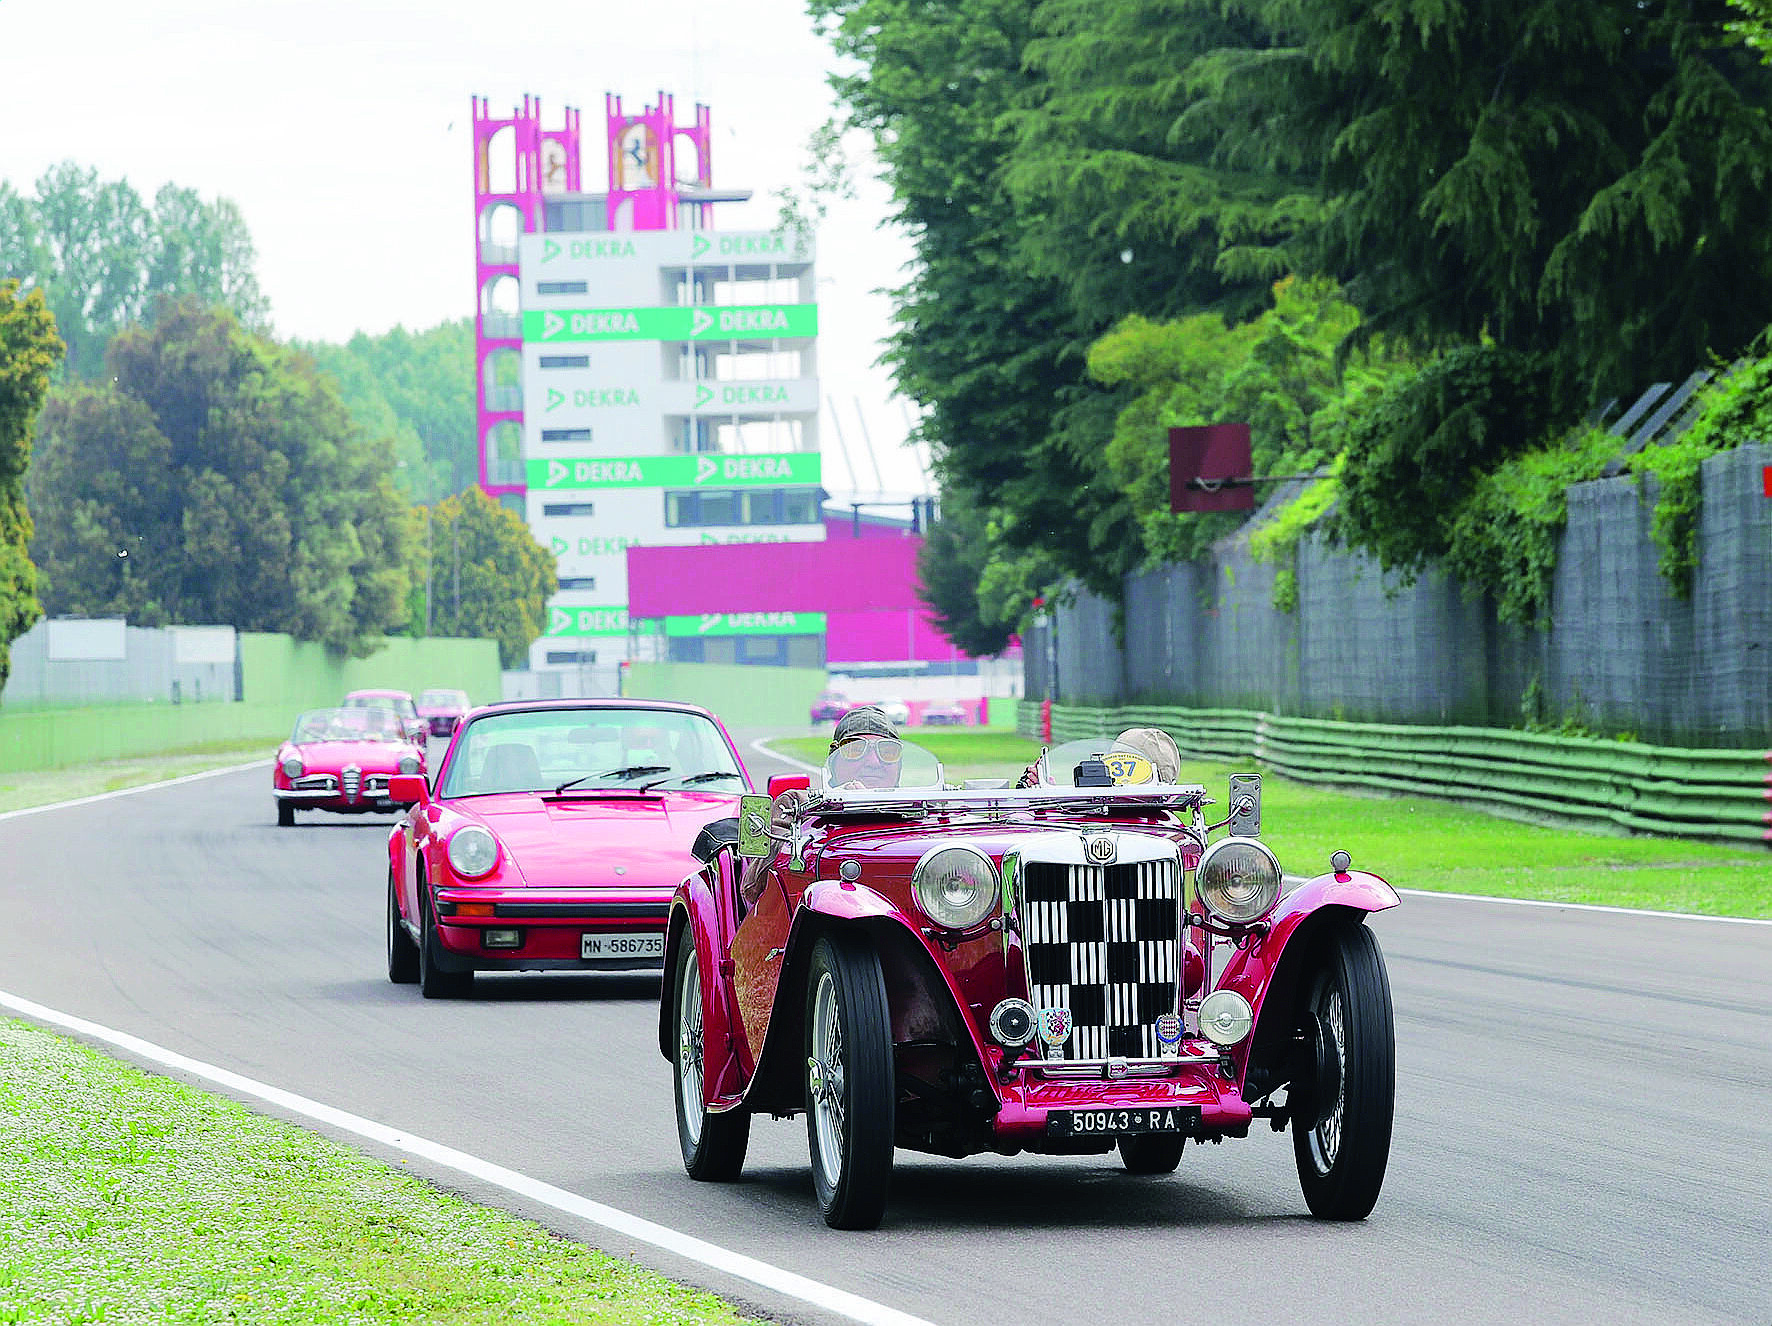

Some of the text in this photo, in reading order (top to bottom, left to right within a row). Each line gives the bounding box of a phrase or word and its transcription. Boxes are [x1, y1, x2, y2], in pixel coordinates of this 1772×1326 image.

[570, 240, 636, 259] DEKRA
[719, 236, 786, 255] DEKRA
[571, 312, 640, 334] DEKRA
[719, 309, 789, 331] DEKRA
[573, 388, 640, 408] DEKRA
[723, 385, 790, 405] DEKRA
[575, 461, 644, 482] DEKRA
[724, 457, 793, 479] DEKRA
[1110, 761, 1137, 777] 37
[1094, 840, 1111, 857] MG
[584, 939, 662, 953] MN 586735
[1073, 1110, 1175, 1132] 50943 RA
